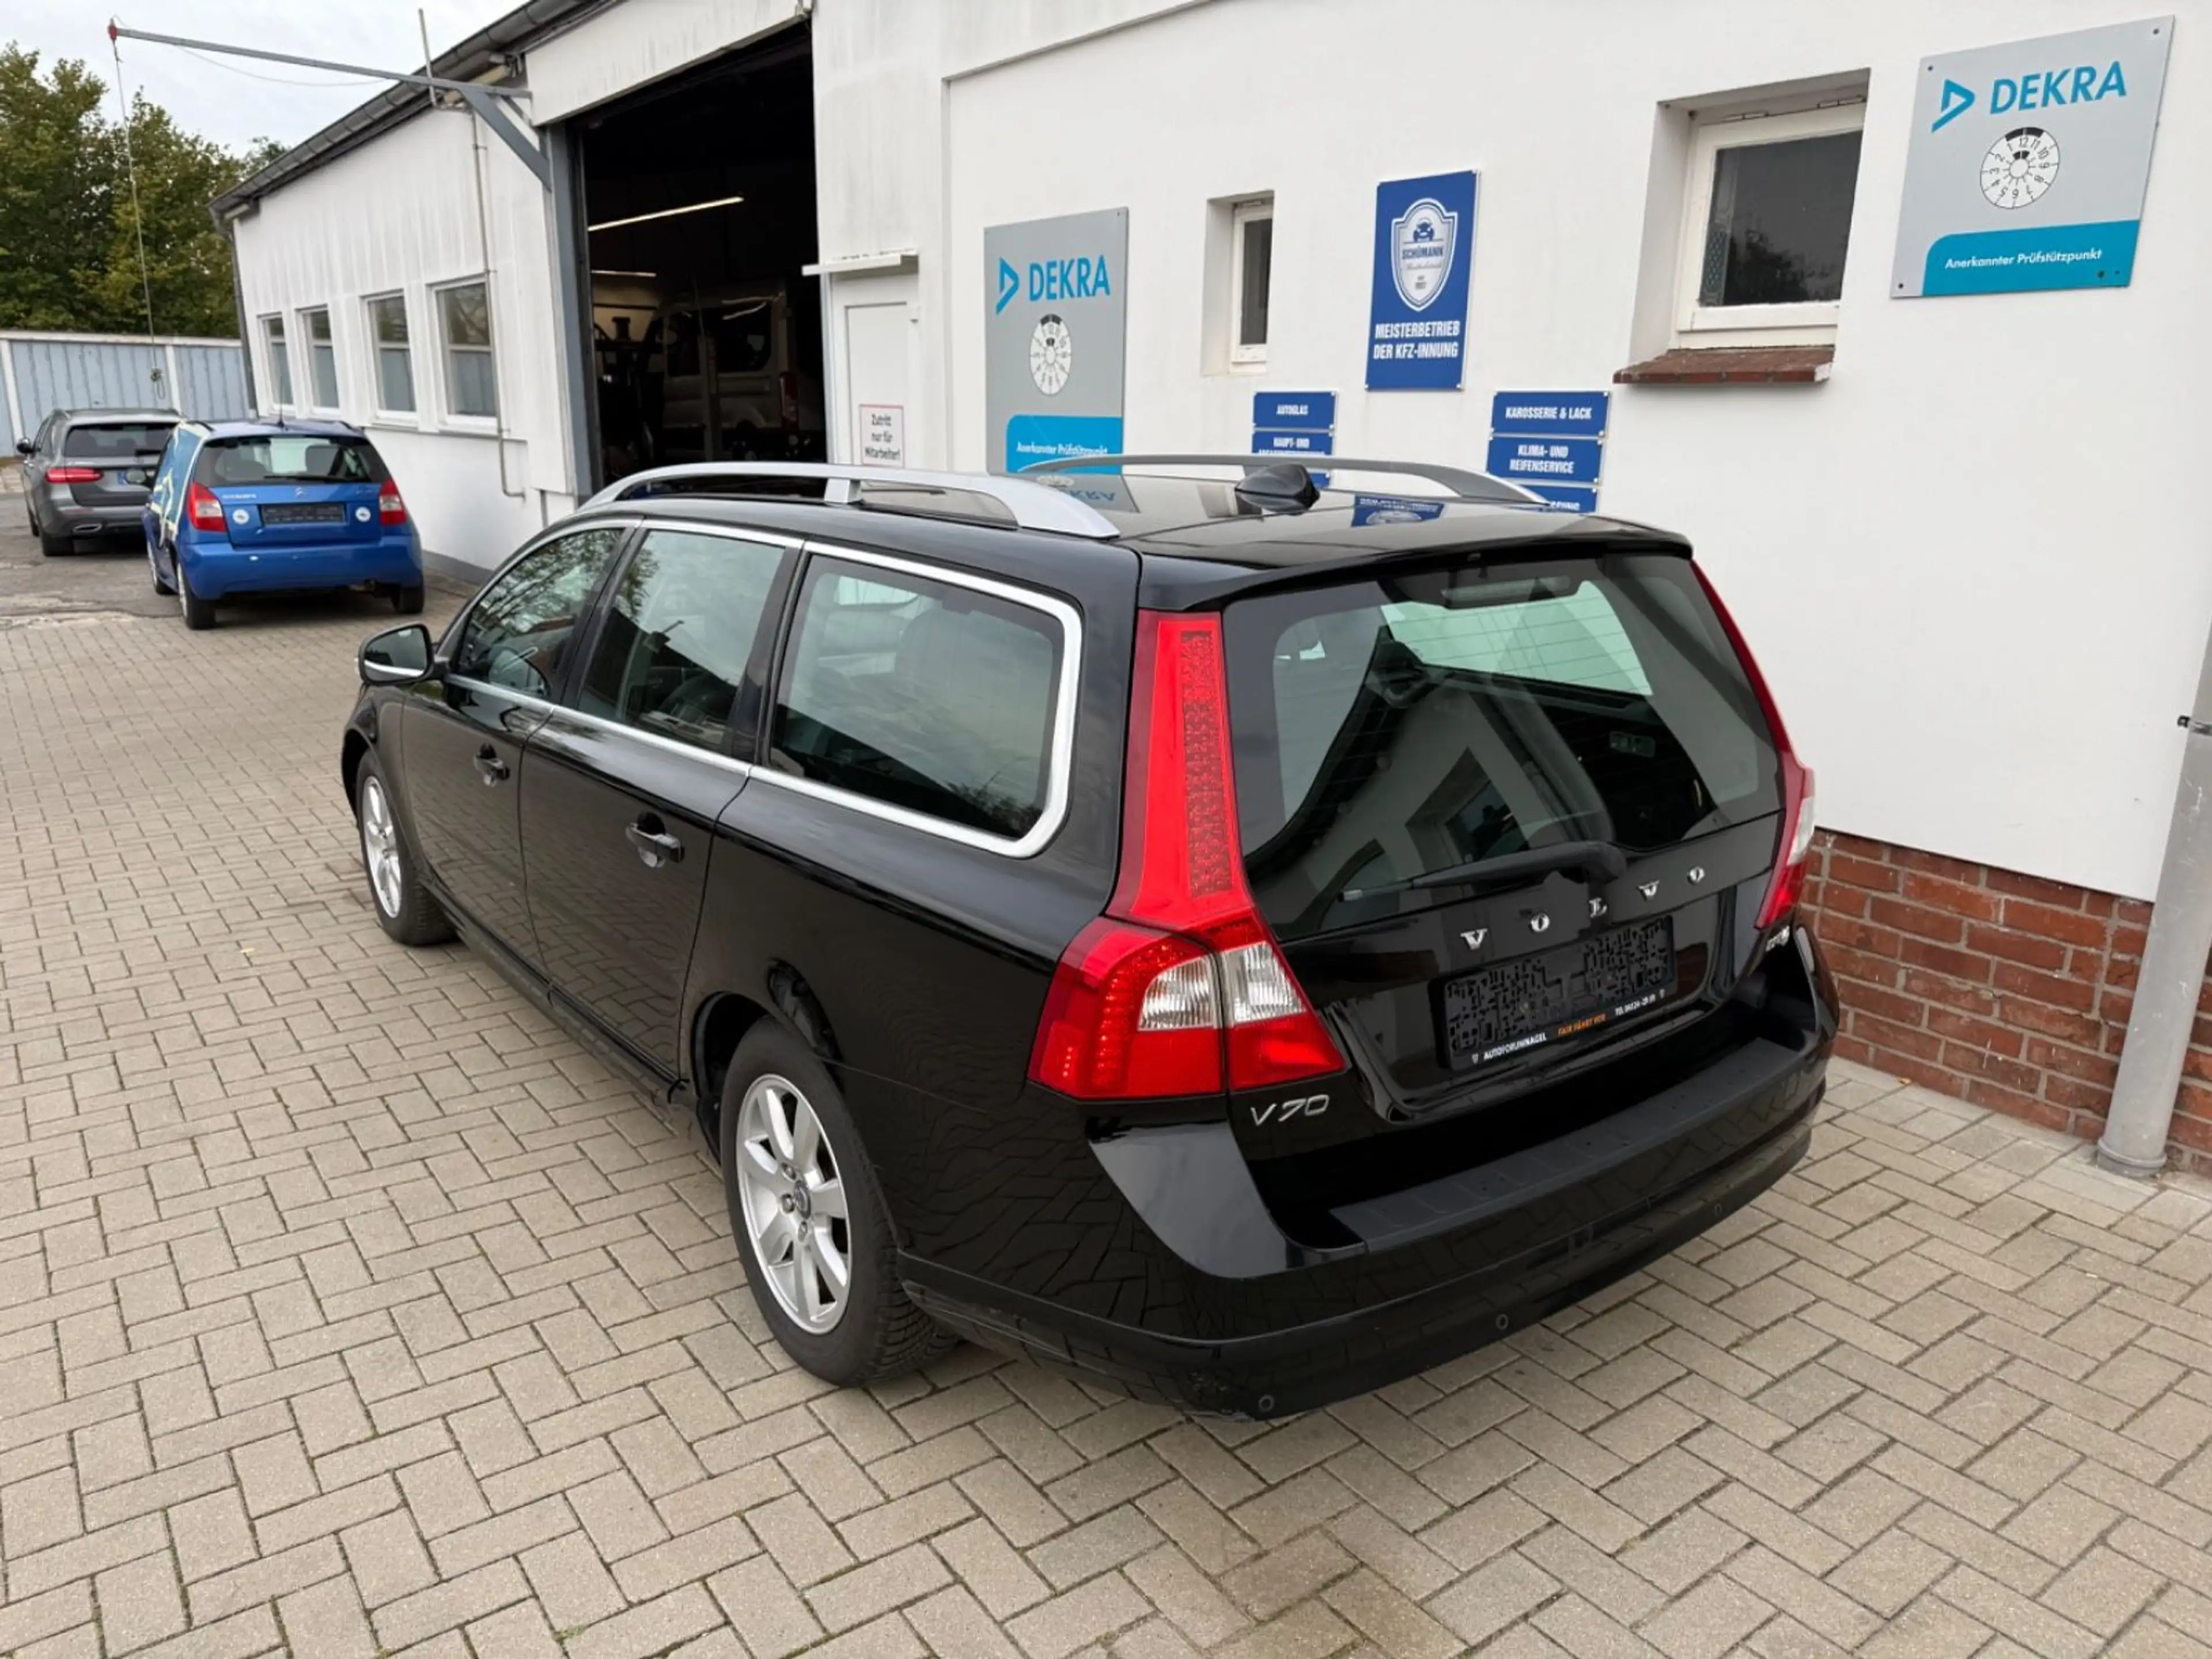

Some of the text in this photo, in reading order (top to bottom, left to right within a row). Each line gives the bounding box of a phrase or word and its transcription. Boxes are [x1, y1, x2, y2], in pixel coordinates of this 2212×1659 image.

[1990, 60, 2127, 115] DEKRA
[1945, 248, 2103, 270] Anerkannter Prüfstützpunkt
[1029, 254, 1111, 301] DEKRA
[1375, 320, 1460, 339] MEISTERBETRIEB
[1374, 341, 1459, 359] DER KFZ-INNUNG
[1276, 404, 1309, 415] AUTOGLAS
[1505, 406, 1592, 420] KAROSSERIE & LACK
[1518, 444, 1569, 458] KLIMA- UND
[1509, 459, 1575, 474] REIFENSERVICE
[1460, 866, 1705, 950] VOLVO
[1250, 1094, 1330, 1127] V70
